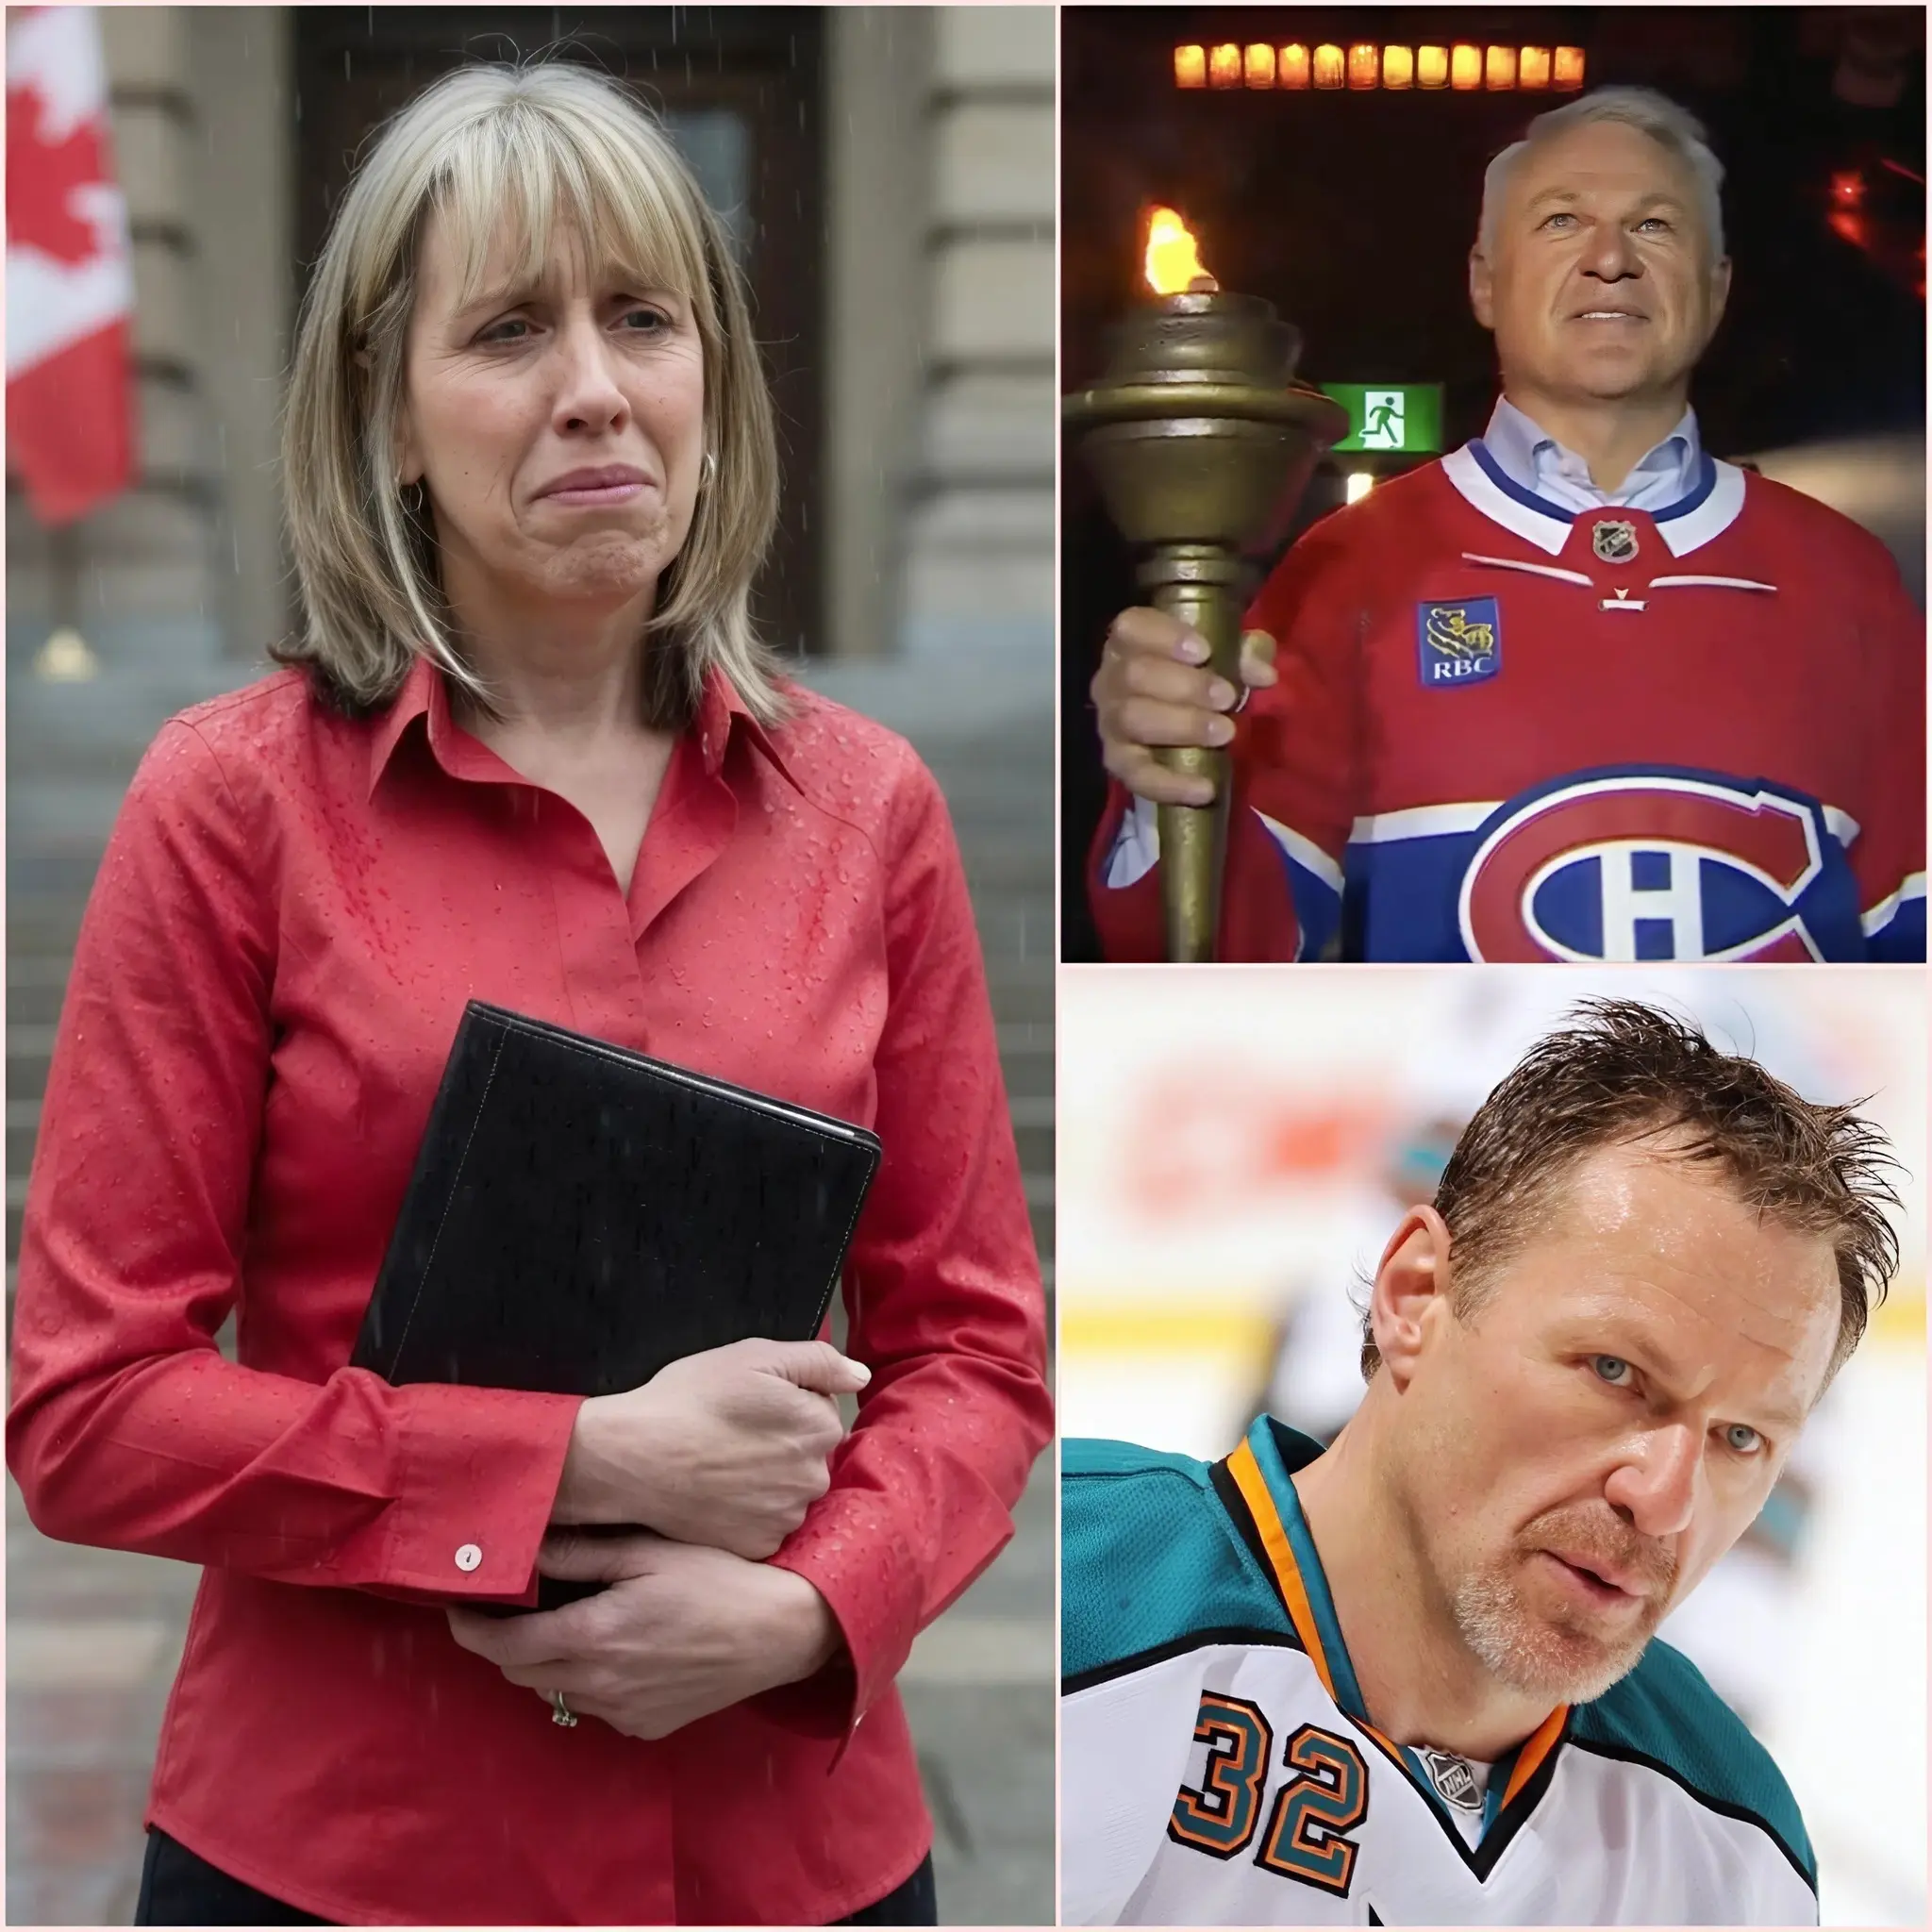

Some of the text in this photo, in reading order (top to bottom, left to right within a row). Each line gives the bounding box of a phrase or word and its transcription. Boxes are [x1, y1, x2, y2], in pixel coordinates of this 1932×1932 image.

[1434, 657, 1494, 679] RBC
[1167, 1690, 1370, 1899] 32
[1442, 1765, 1472, 1796] NHL
